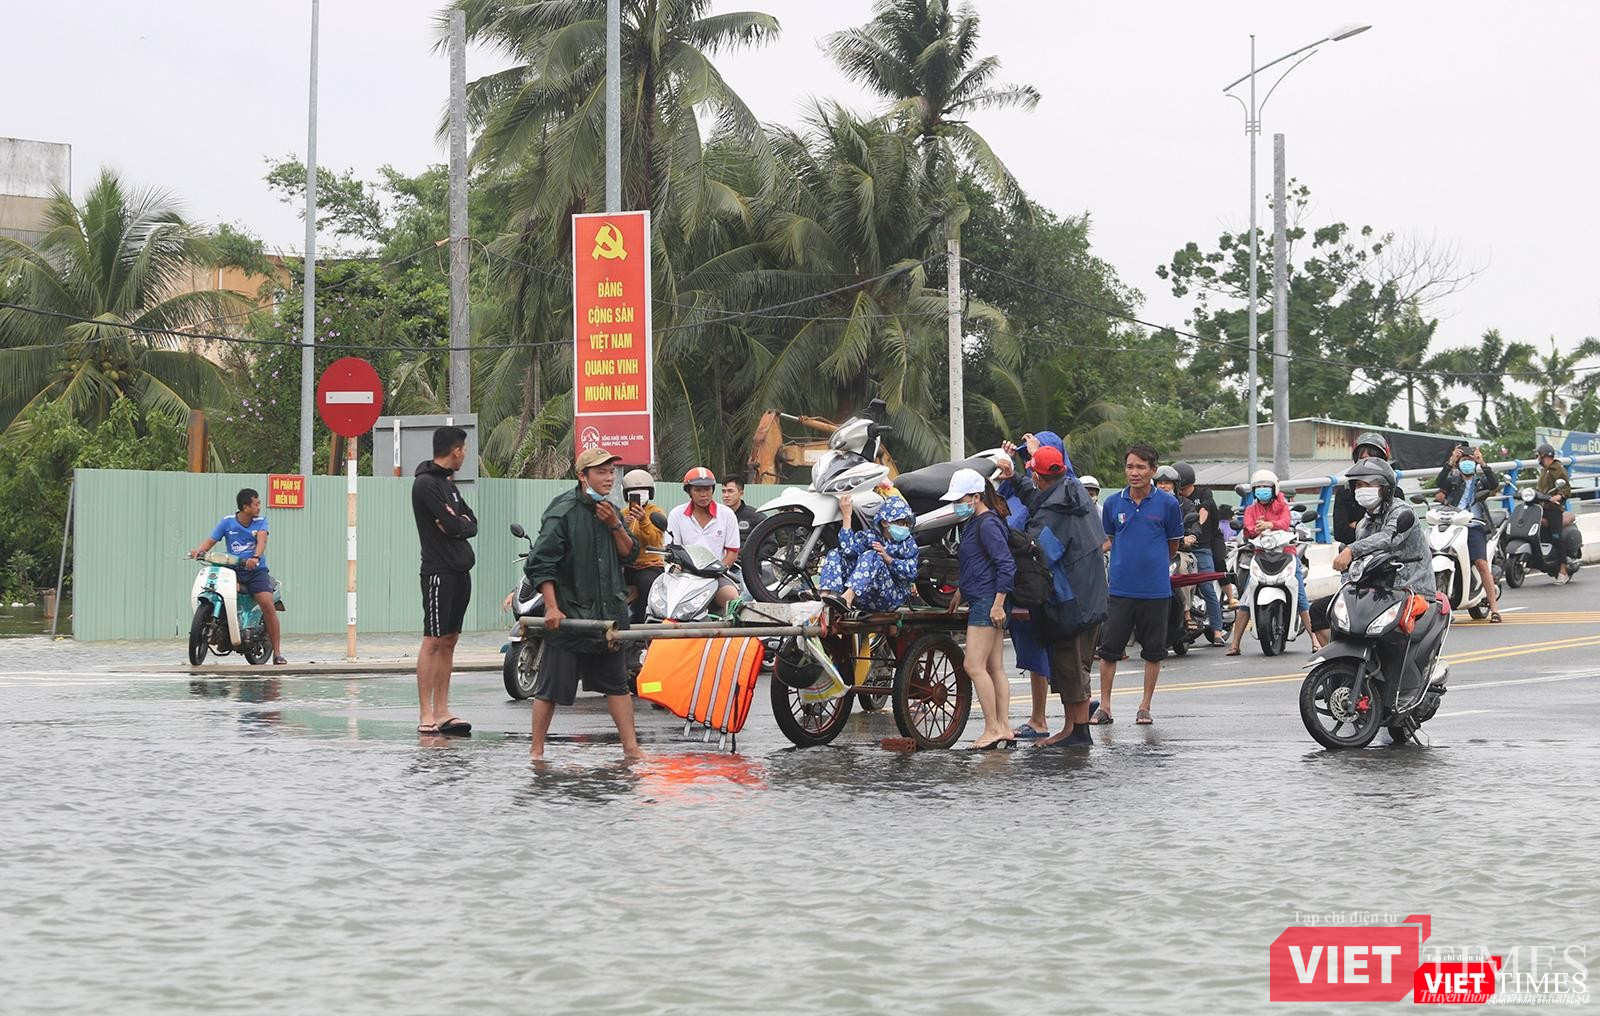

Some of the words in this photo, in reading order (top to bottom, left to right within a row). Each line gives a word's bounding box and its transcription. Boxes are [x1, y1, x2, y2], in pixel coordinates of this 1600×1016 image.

[598, 277, 623, 298] ĐẢNG
[588, 305, 613, 327] CỘNG
[615, 302, 634, 323] SẢN
[589, 331, 609, 353] VIỆT
[611, 333, 633, 349] NAM
[585, 359, 615, 377] QUANG
[617, 359, 639, 375] VINH
[585, 382, 612, 402] MUÔN
[614, 382, 639, 401] NĂM!
